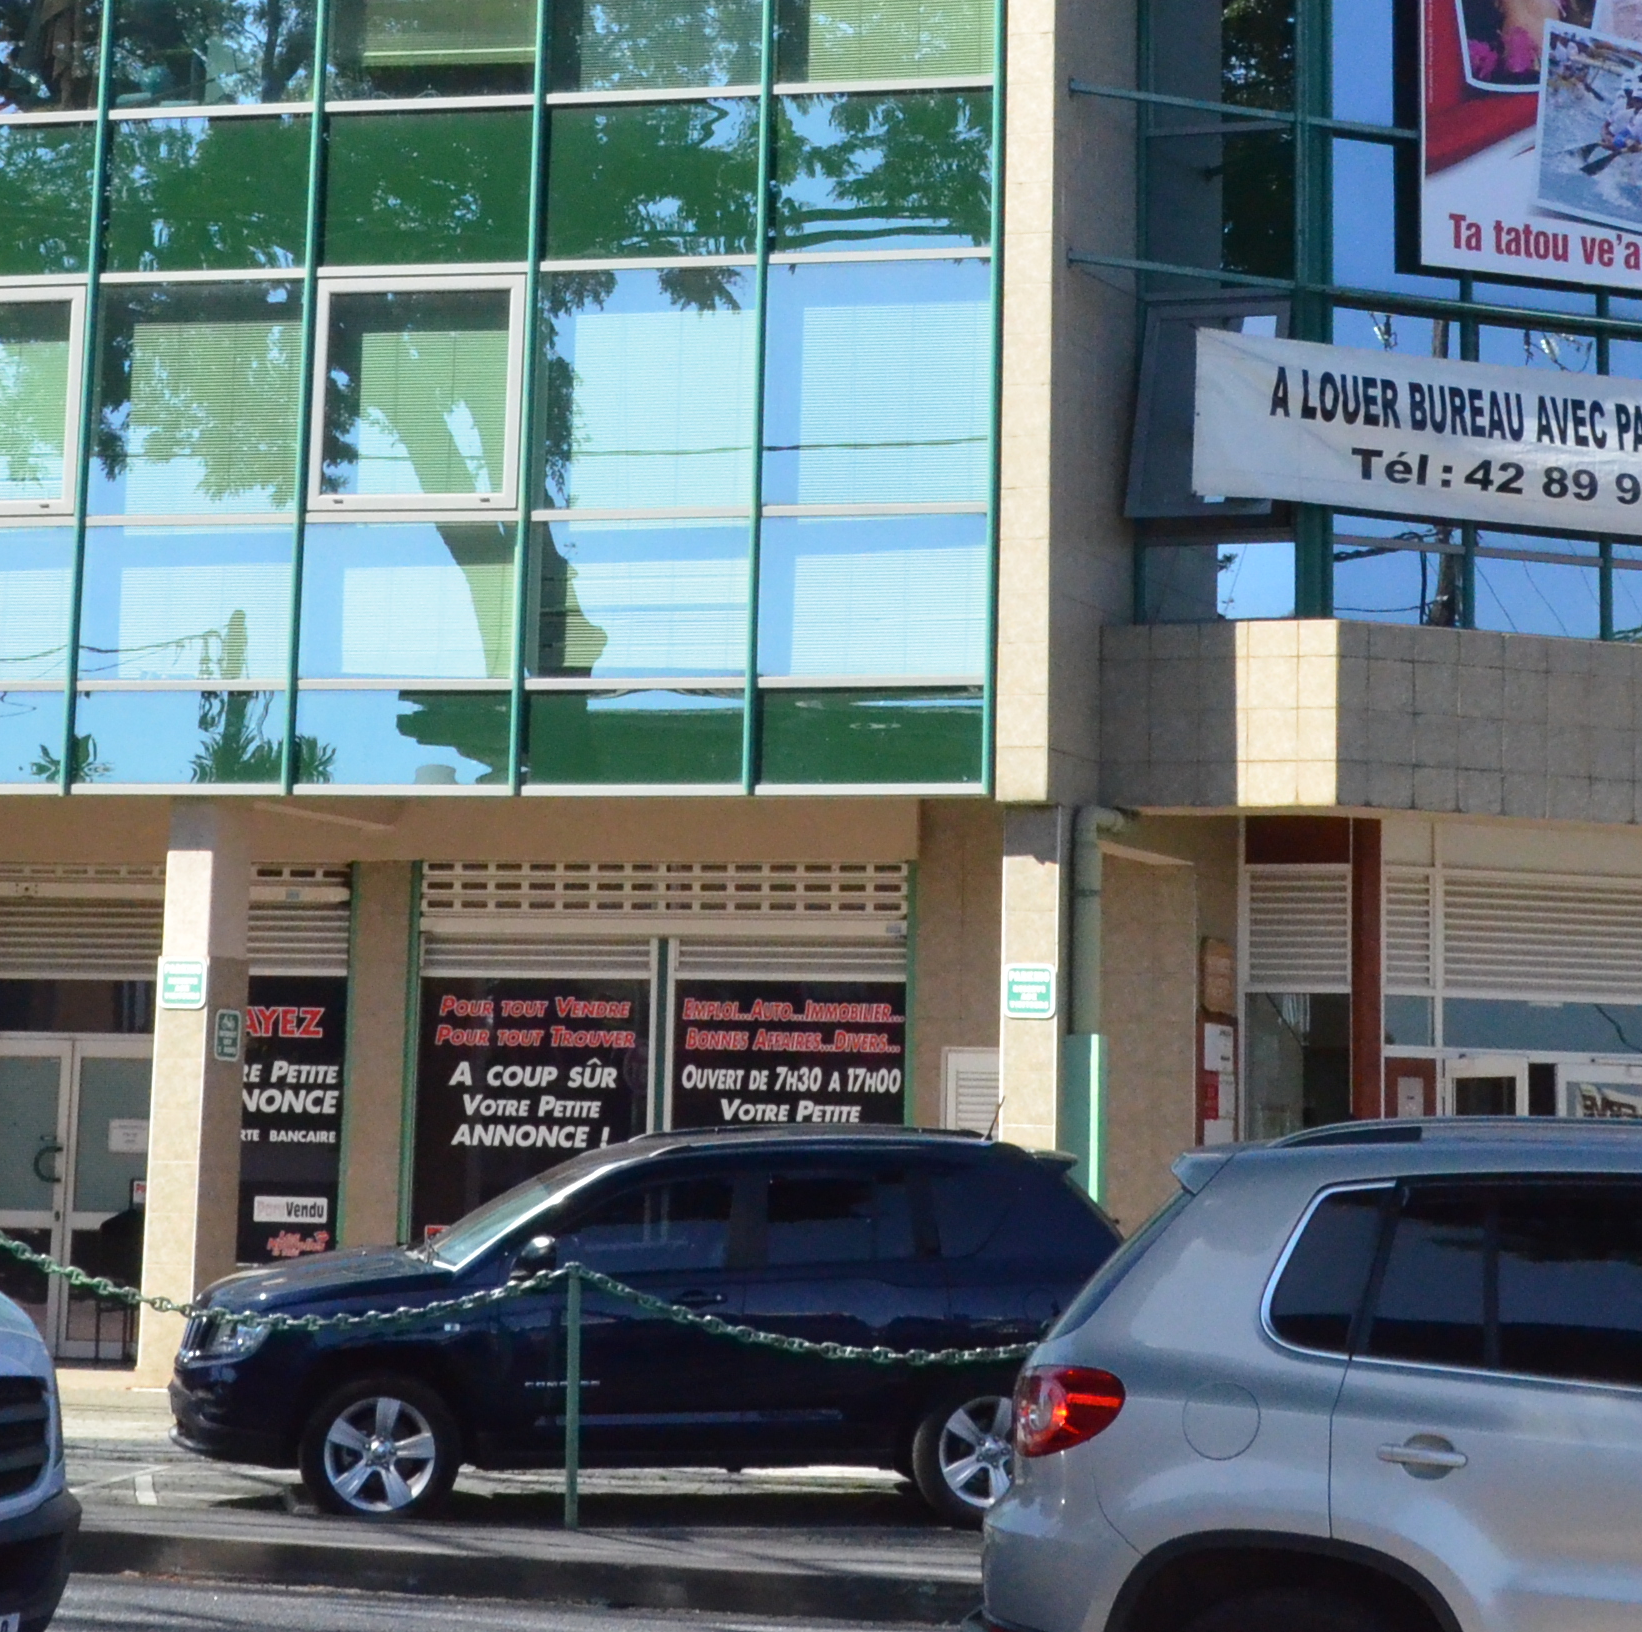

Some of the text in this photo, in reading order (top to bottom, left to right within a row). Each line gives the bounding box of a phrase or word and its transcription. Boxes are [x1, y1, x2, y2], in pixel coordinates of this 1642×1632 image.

[1449, 213, 1640, 270] Ta tatou ve'a
[1270, 366, 1290, 417] A
[1301, 369, 1401, 429] LOUER
[1409, 382, 1524, 441] BUREAU
[1537, 396, 1607, 449] AVEC
[1464, 460, 1525, 495] 42
[1542, 467, 1598, 501] 89
[439, 995, 631, 1018] POUR TOUT VENDRE
[435, 1025, 635, 1048] POUR TOUT TROUVER
[686, 1027, 749, 1050] BONNES
[270, 1061, 339, 1083] PETITE
[449, 1057, 617, 1088] A COUP SÛR
[682, 1065, 901, 1093] OUVERT DE 7H30 A 17H00
[463, 1094, 602, 1118] VOTRE PETITE
[721, 1099, 861, 1123] VOTRE PETITE
[269, 1130, 336, 1143] BANCAIRE
[451, 1124, 589, 1148] ANNONCE
